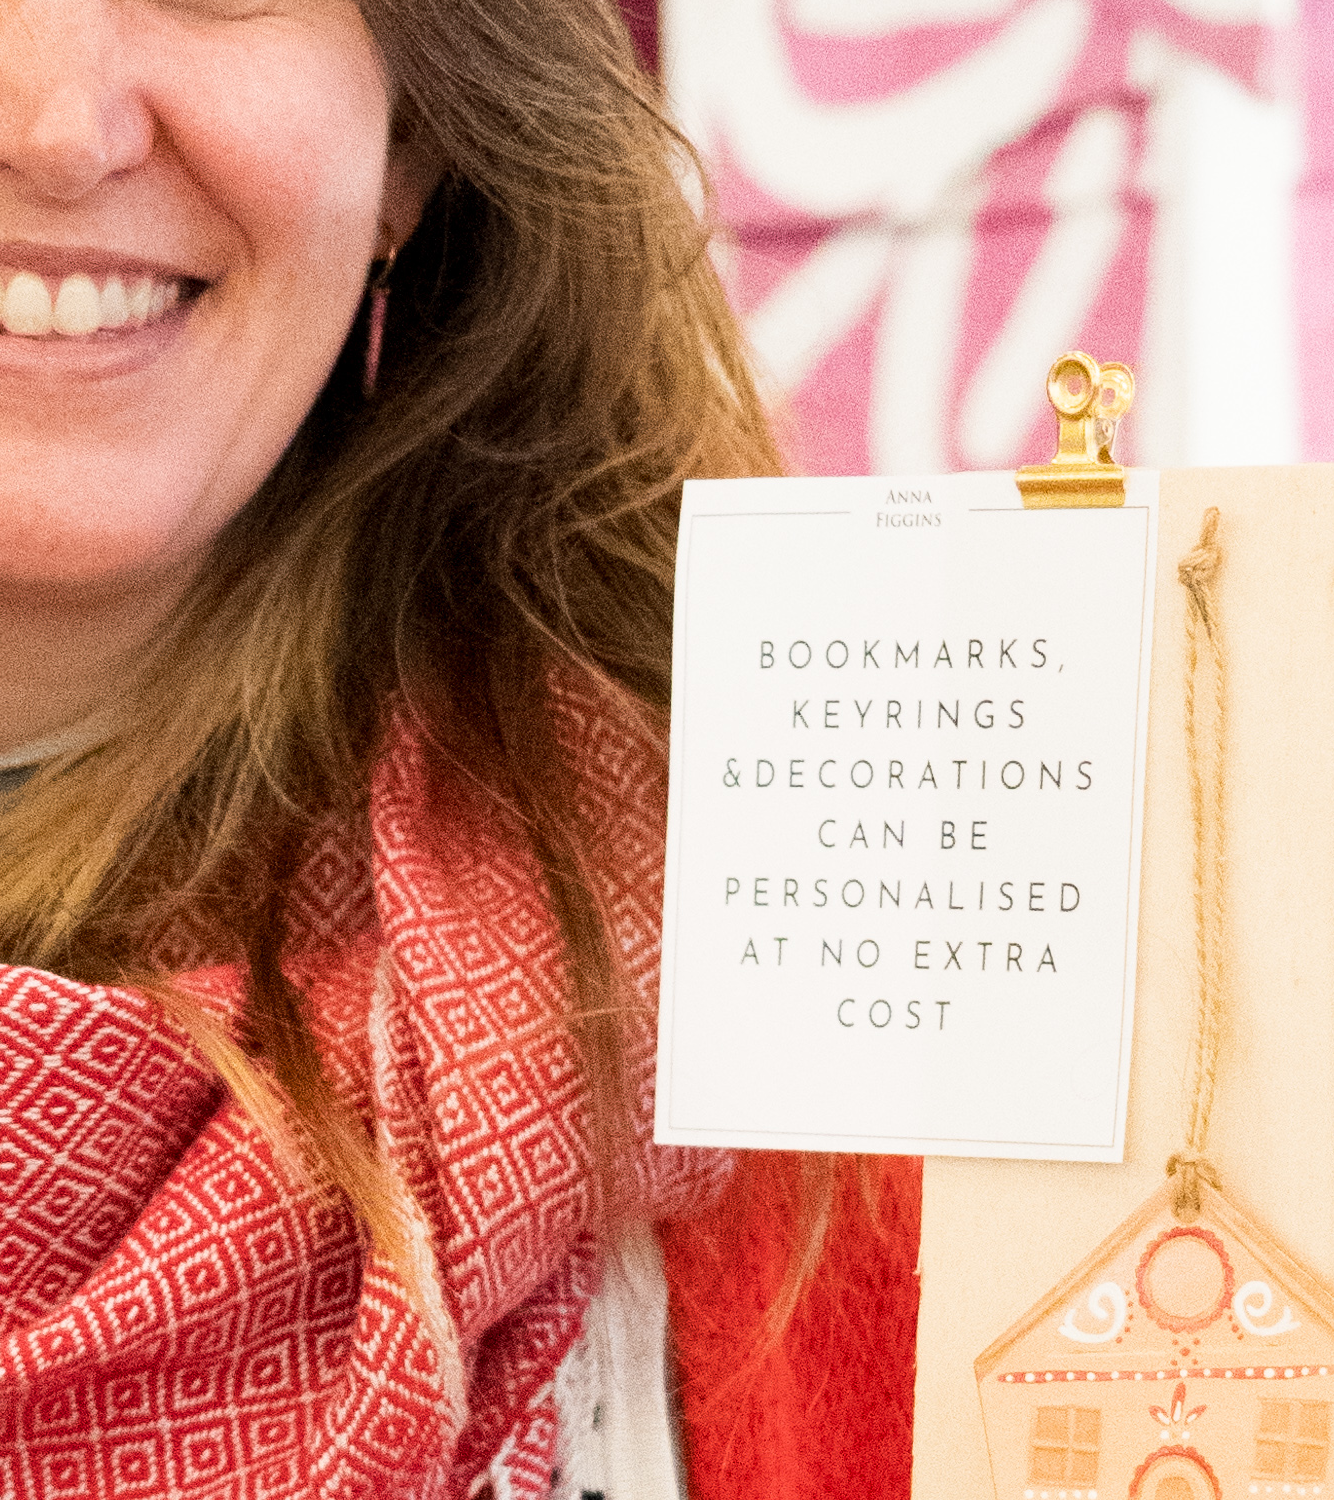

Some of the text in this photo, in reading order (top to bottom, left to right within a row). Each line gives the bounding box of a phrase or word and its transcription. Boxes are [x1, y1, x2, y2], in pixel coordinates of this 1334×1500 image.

[884, 488, 933, 505] ANNA
[875, 510, 943, 529] FIGGINS
[760, 638, 1064, 672] BOOKMARKS,
[792, 698, 1025, 730] KEYRINGS
[722, 757, 1093, 791] &DECORATIONS
[818, 818, 988, 851] CAN BE
[725, 877, 1081, 913] PERSONALISED
[741, 936, 1057, 973] AT NO EXTRA
[837, 998, 951, 1030] COST
